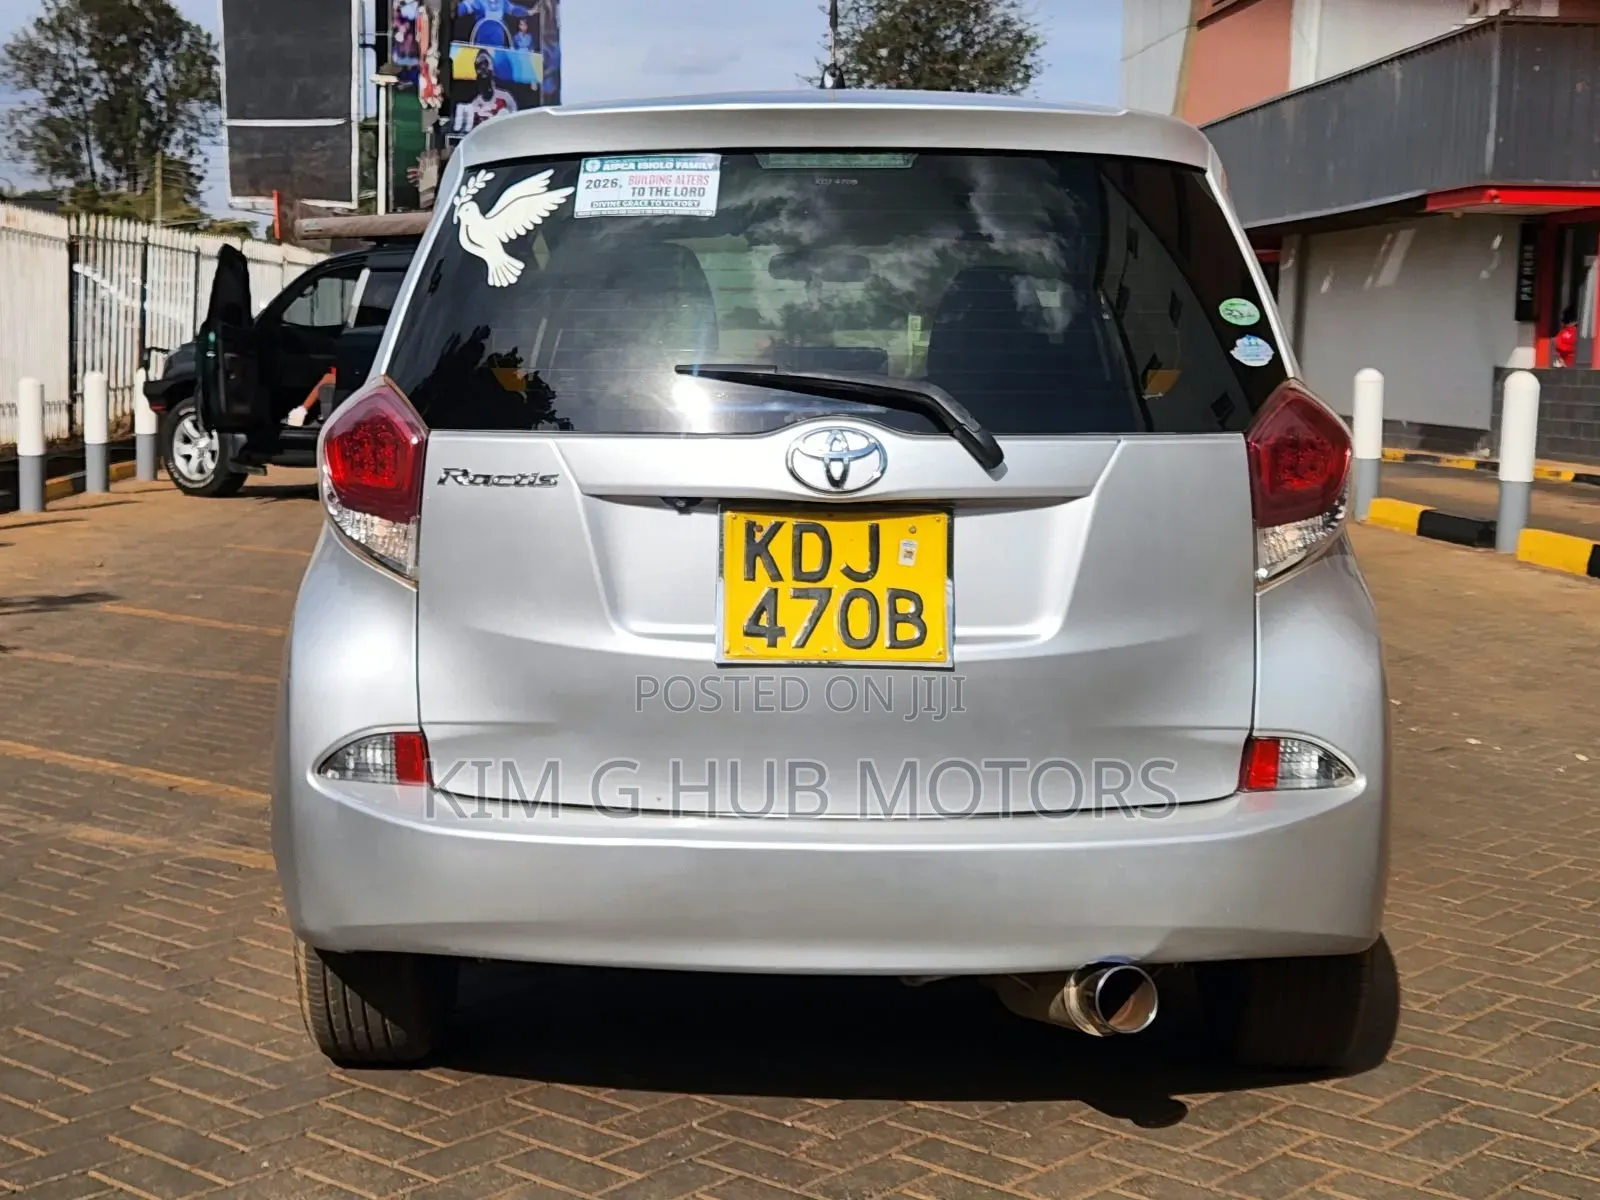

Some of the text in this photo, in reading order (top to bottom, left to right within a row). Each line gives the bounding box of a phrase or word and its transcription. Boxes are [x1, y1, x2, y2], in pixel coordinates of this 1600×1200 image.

[675, 159, 715, 170] FAMILY
[628, 174, 710, 185] BUILDING ALTERS
[631, 187, 706, 197] TO THE LORD
[623, 200, 649, 208] GRACE
[662, 200, 700, 208] VICTORY
[1520, 279, 1533, 300] PAY
[437, 468, 559, 487] Ractis
[744, 520, 880, 583] KDJ
[743, 587, 927, 650] 470B
